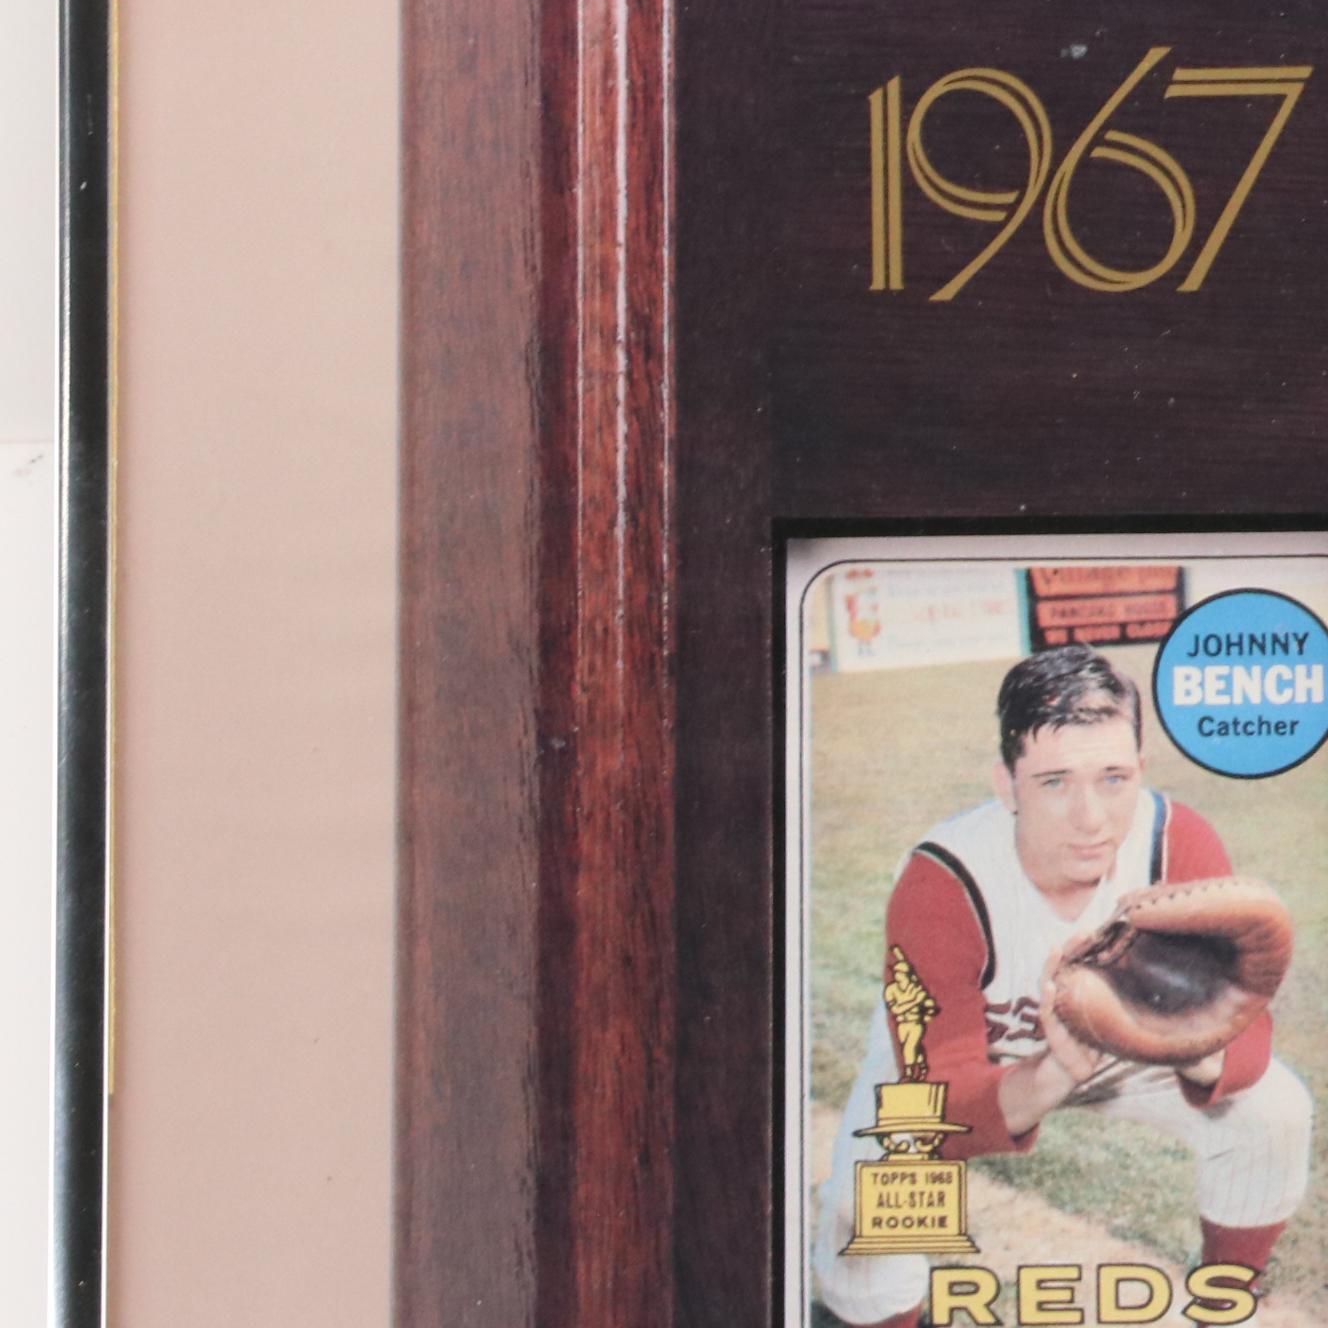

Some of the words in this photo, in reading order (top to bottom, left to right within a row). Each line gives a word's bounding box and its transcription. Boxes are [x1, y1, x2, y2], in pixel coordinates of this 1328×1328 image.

[868, 46, 1315, 302] 1967
[1186, 631, 1311, 658] JOHNNY
[1172, 664, 1326, 707] BENCH
[1196, 714, 1300, 738] Catcher
[871, 1170, 918, 1187] TOPPS
[875, 1190, 946, 1210] ALL-STAR
[870, 1214, 949, 1230] ROOKIE
[929, 1262, 1259, 1328] REDS
